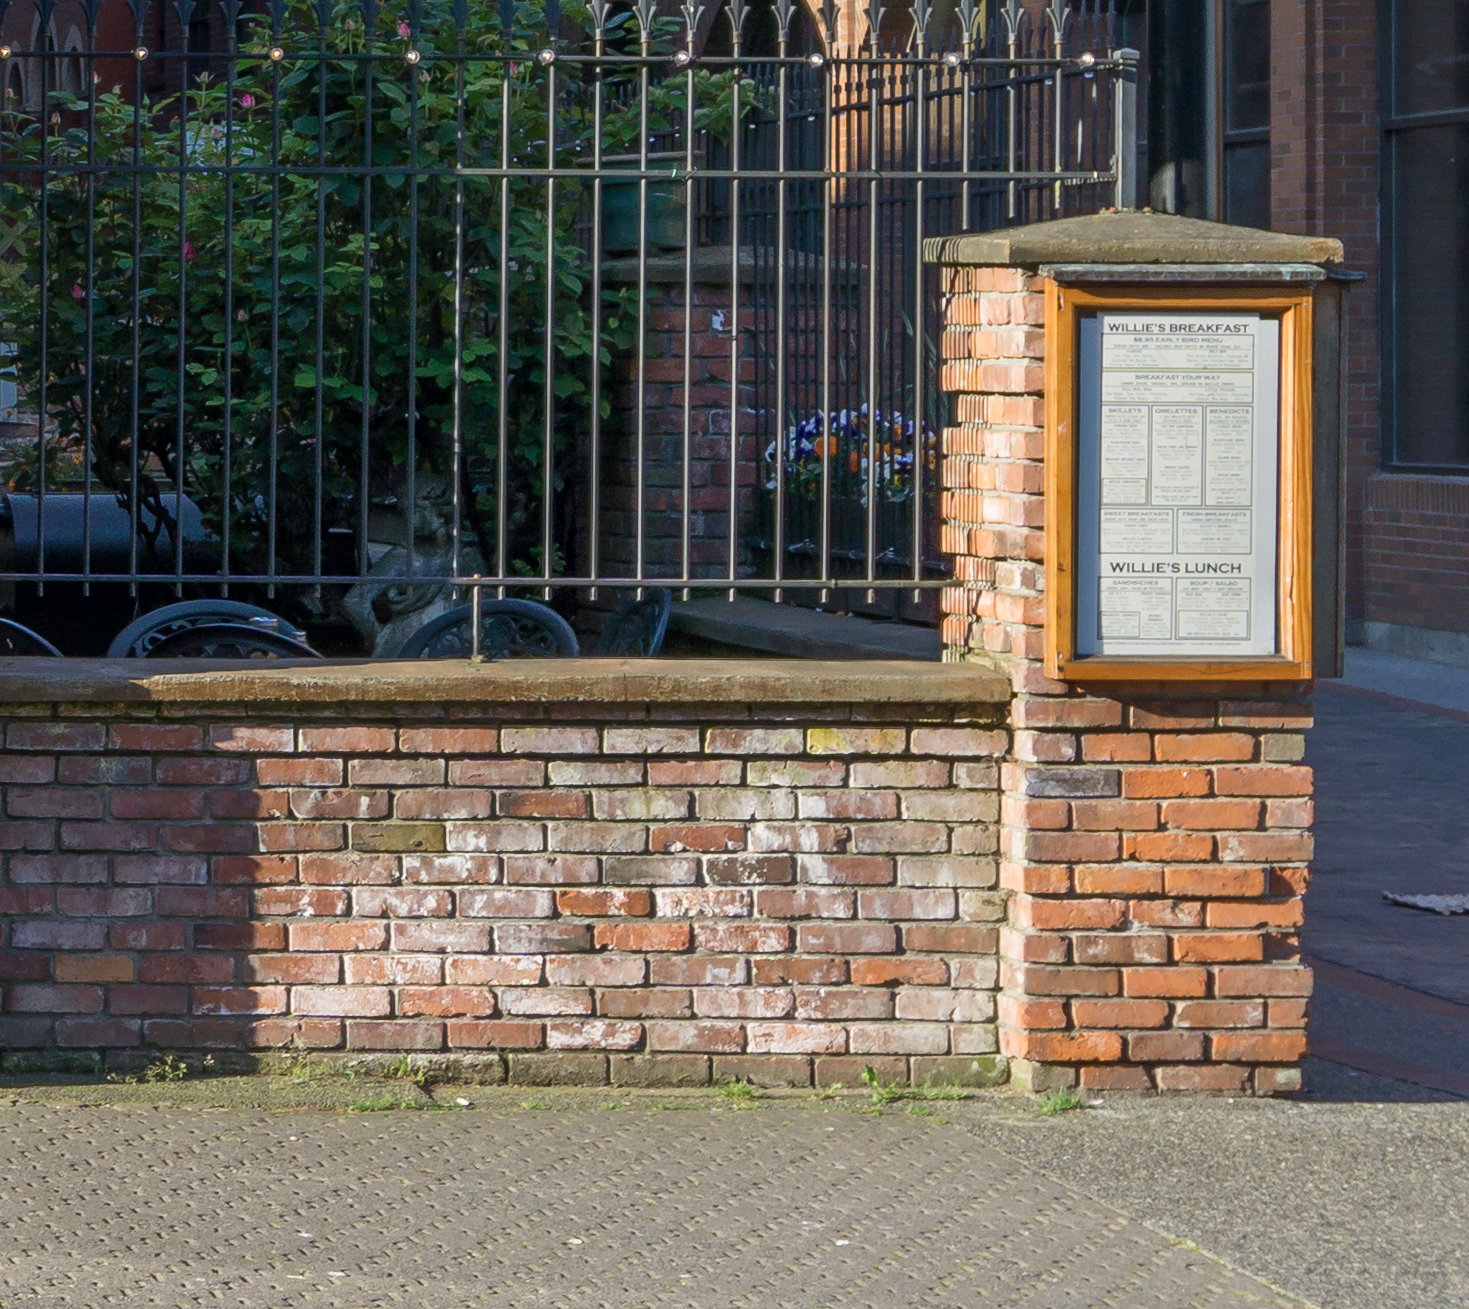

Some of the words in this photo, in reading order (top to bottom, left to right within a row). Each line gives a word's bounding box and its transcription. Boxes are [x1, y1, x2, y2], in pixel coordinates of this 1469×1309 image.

[1108, 323, 1166, 333] WILLIE'S
[1169, 323, 1250, 333] BREAKFAST
[1109, 562, 1181, 573] WILLIE'S
[1184, 562, 1242, 574] LUNCH
